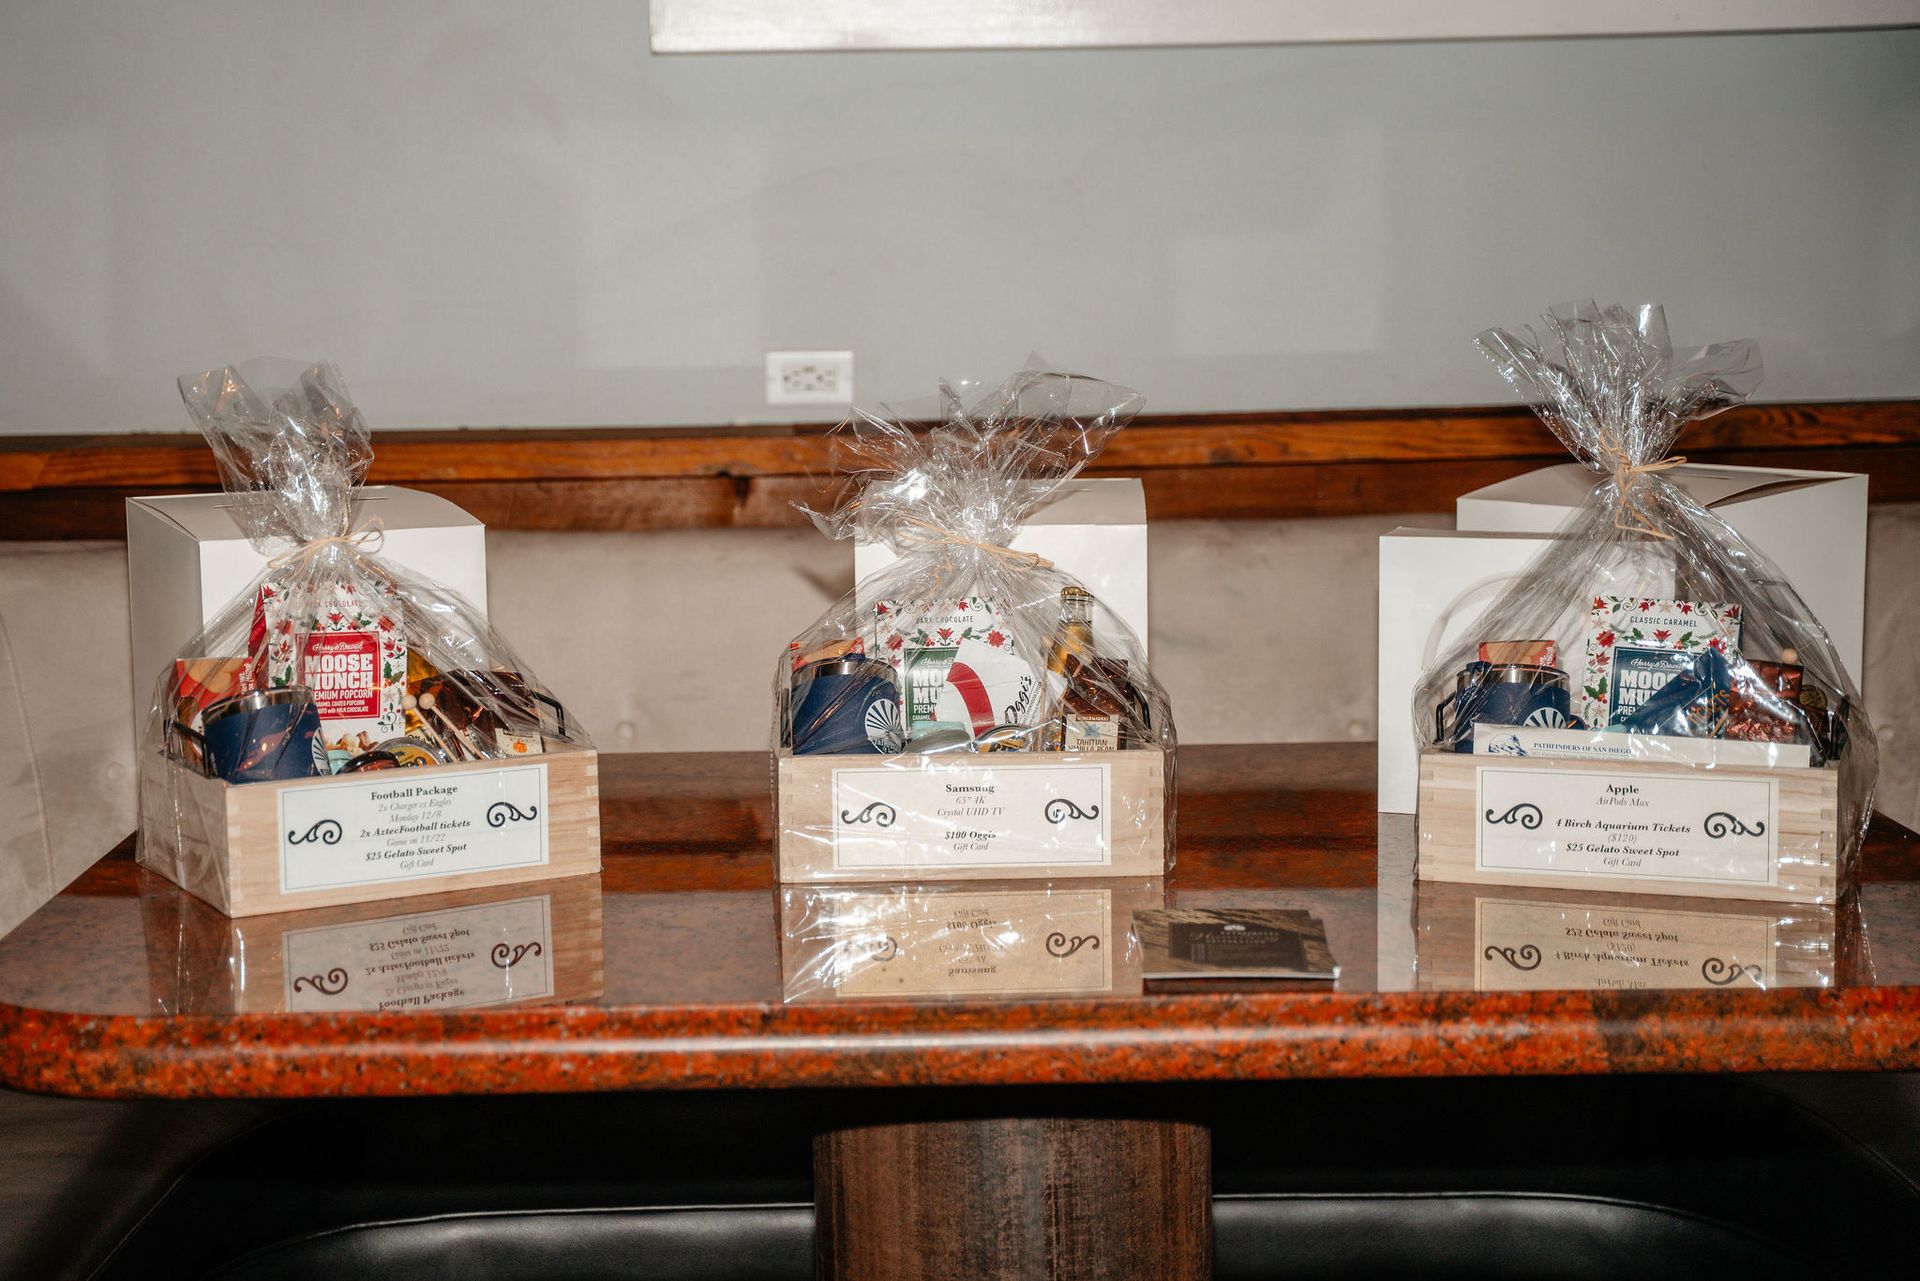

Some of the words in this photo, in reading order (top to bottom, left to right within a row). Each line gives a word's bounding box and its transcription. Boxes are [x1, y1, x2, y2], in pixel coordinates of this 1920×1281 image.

[916, 616, 932, 624] DARK
[936, 615, 974, 623] CHOCOLATE
[1630, 616, 1660, 625] CLASSIC
[1664, 616, 1698, 628] CARAMEL
[304, 653, 374, 672] MOOSE
[304, 671, 373, 690] MUNCH
[314, 690, 338, 701] EMIUM
[340, 688, 372, 700] POPCORN
[1005, 675, 1031, 724] Oggi's
[914, 704, 935, 714] PREM
[1076, 738, 1108, 746] TAHITIAN
[1534, 742, 1580, 751] PATHFINDERS
[371, 789, 413, 800] Football
[416, 786, 458, 798] Package
[946, 784, 995, 794] Samsung
[1606, 784, 1640, 796] Apple
[378, 803, 388, 812] 2x
[390, 801, 418, 812] Charger
[429, 798, 452, 808] Eagles
[1596, 796, 1627, 806] AirPods
[1629, 798, 1649, 807] Max
[390, 813, 419, 824] Monday
[421, 810, 442, 820] 12/8
[937, 808, 963, 818] Crystal
[966, 808, 989, 816] UHD
[990, 807, 1005, 816] TV
[360, 829, 371, 838] 2x
[373, 822, 437, 837] AztecFootball
[440, 820, 471, 830] tickets
[1556, 819, 1561, 827] 4
[1564, 819, 1592, 828] Birch
[1595, 820, 1649, 832] Aquarium
[1652, 823, 1691, 833] Tickets
[386, 838, 407, 848] Game
[420, 834, 445, 844] 11/22
[945, 831, 966, 840] $100
[969, 830, 996, 841] Oggis
[1608, 834, 1637, 842] ($120)
[365, 852, 382, 862] $25
[384, 847, 415, 859] Gelato
[417, 846, 444, 857] Sweet
[446, 843, 467, 854] Spot
[953, 843, 968, 853] Gift
[970, 842, 989, 850] Card
[1566, 843, 1583, 852] $25
[1586, 844, 1620, 854] Gelato
[1623, 846, 1653, 856] Sweet
[1656, 848, 1680, 858] Spot
[400, 859, 414, 870] Gift
[416, 858, 434, 868] Card
[1604, 857, 1619, 867] Gift
[1622, 858, 1642, 867] Card
